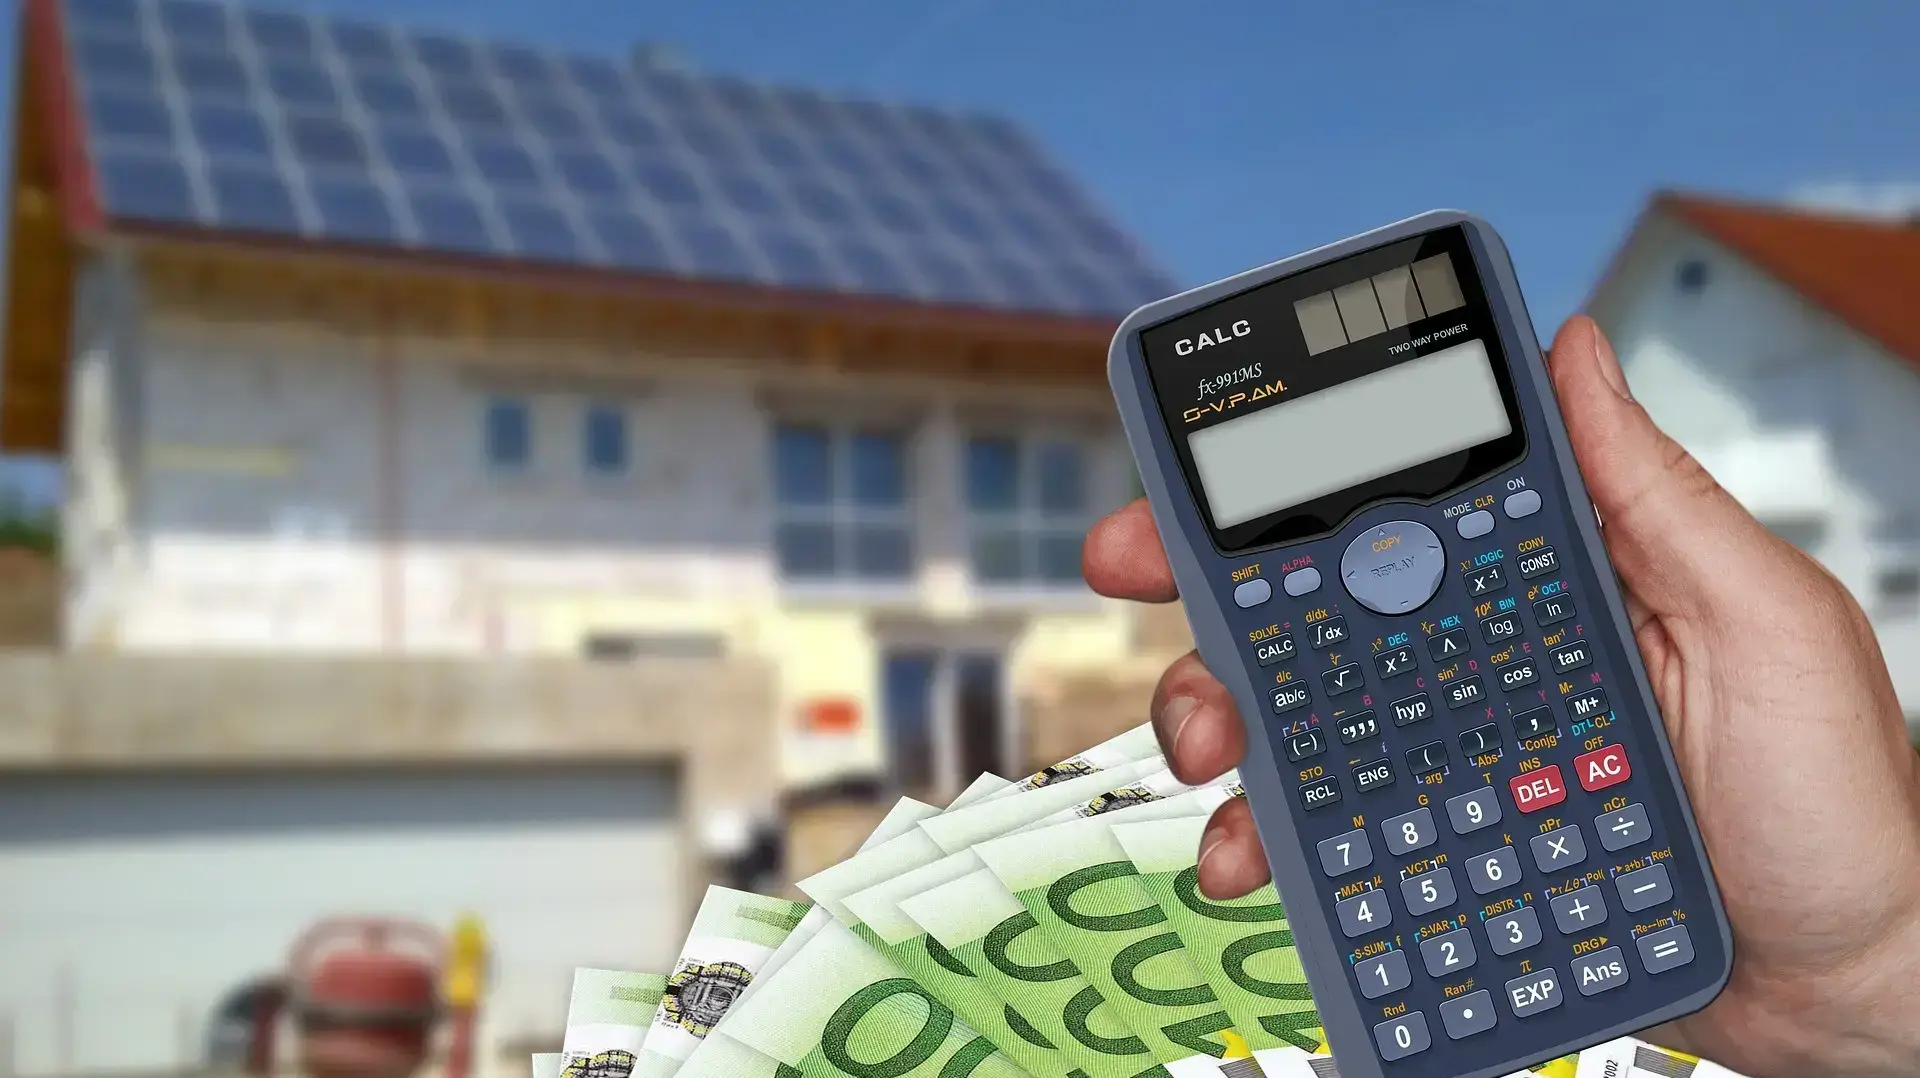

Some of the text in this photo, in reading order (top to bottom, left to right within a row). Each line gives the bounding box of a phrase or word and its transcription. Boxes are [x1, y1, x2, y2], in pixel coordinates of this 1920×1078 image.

[1175, 320, 1251, 356] CALC
[1388, 323, 1468, 355] TWO WAY POWER
[1197, 362, 1263, 401] fx-991MS
[1506, 477, 1526, 491] ON
[1443, 495, 1495, 519] MODE CLR
[1372, 535, 1401, 552] COPY
[1518, 536, 1544, 552] CONV
[1282, 555, 1313, 572] ALPHA
[1371, 556, 1415, 578] REPLAY
[1474, 549, 1504, 567] LOGIC
[1520, 552, 1555, 574] CONST
[1231, 563, 1261, 582] SHIFT
[1541, 581, 1561, 595] OCT
[1499, 597, 1516, 610] BIN
[1305, 608, 1328, 623] d/dx
[1440, 615, 1460, 629] HEX
[1249, 624, 1280, 642] SOLVE
[1489, 619, 1514, 636] log
[1576, 625, 1584, 636] F
[1388, 632, 1408, 647] DEC
[1522, 642, 1532, 653] E
[1258, 639, 1293, 660] CALC
[1558, 648, 1585, 666] tan
[1469, 660, 1478, 671] D
[1276, 671, 1292, 684] d/c
[1416, 677, 1425, 688] C
[1504, 666, 1533, 684] cos
[1590, 672, 1602, 684] M
[1362, 694, 1372, 706] B
[1453, 683, 1478, 701] sin
[1538, 689, 1546, 701] Y
[1395, 700, 1426, 720] hyp
[1485, 707, 1494, 719] X
[1574, 696, 1599, 715] M+
[1525, 734, 1558, 752] Conjg
[1584, 736, 1604, 751] OFF
[1478, 753, 1499, 768] Abs
[1519, 757, 1541, 773] INS
[1588, 755, 1622, 783] AC
[1300, 766, 1323, 781] STO
[1358, 766, 1389, 786] ENG
[1425, 771, 1443, 785] arg
[1483, 772, 1491, 784] T
[1305, 785, 1335, 803] RCL
[1517, 777, 1560, 804] DEL
[1418, 794, 1429, 806] G
[1603, 796, 1626, 813] nCr
[1353, 815, 1365, 828] M
[1466, 801, 1483, 824] 9
[1402, 822, 1419, 845] 8
[1539, 818, 1561, 833] nPr
[1336, 842, 1351, 867] 7
[1406, 853, 1448, 875] VCT m
[1485, 858, 1502, 881] 6
[1340, 881, 1364, 897] MAT
[1421, 879, 1437, 902] 5
[1357, 900, 1373, 923] 4
[1485, 892, 1533, 916] DISTR n
[1420, 920, 1450, 938] S-VAR
[1505, 920, 1523, 944] 3
[1354, 941, 1386, 960] S-SUM
[1440, 942, 1459, 967] 2
[1573, 938, 1600, 955] DRG
[1374, 963, 1389, 987] 1
[1582, 961, 1622, 986] Ans
[1444, 977, 1475, 997] Ran#
[1511, 979, 1554, 1008] EXP
[1383, 1002, 1406, 1018] Rnd
[1394, 1025, 1411, 1048] 0
